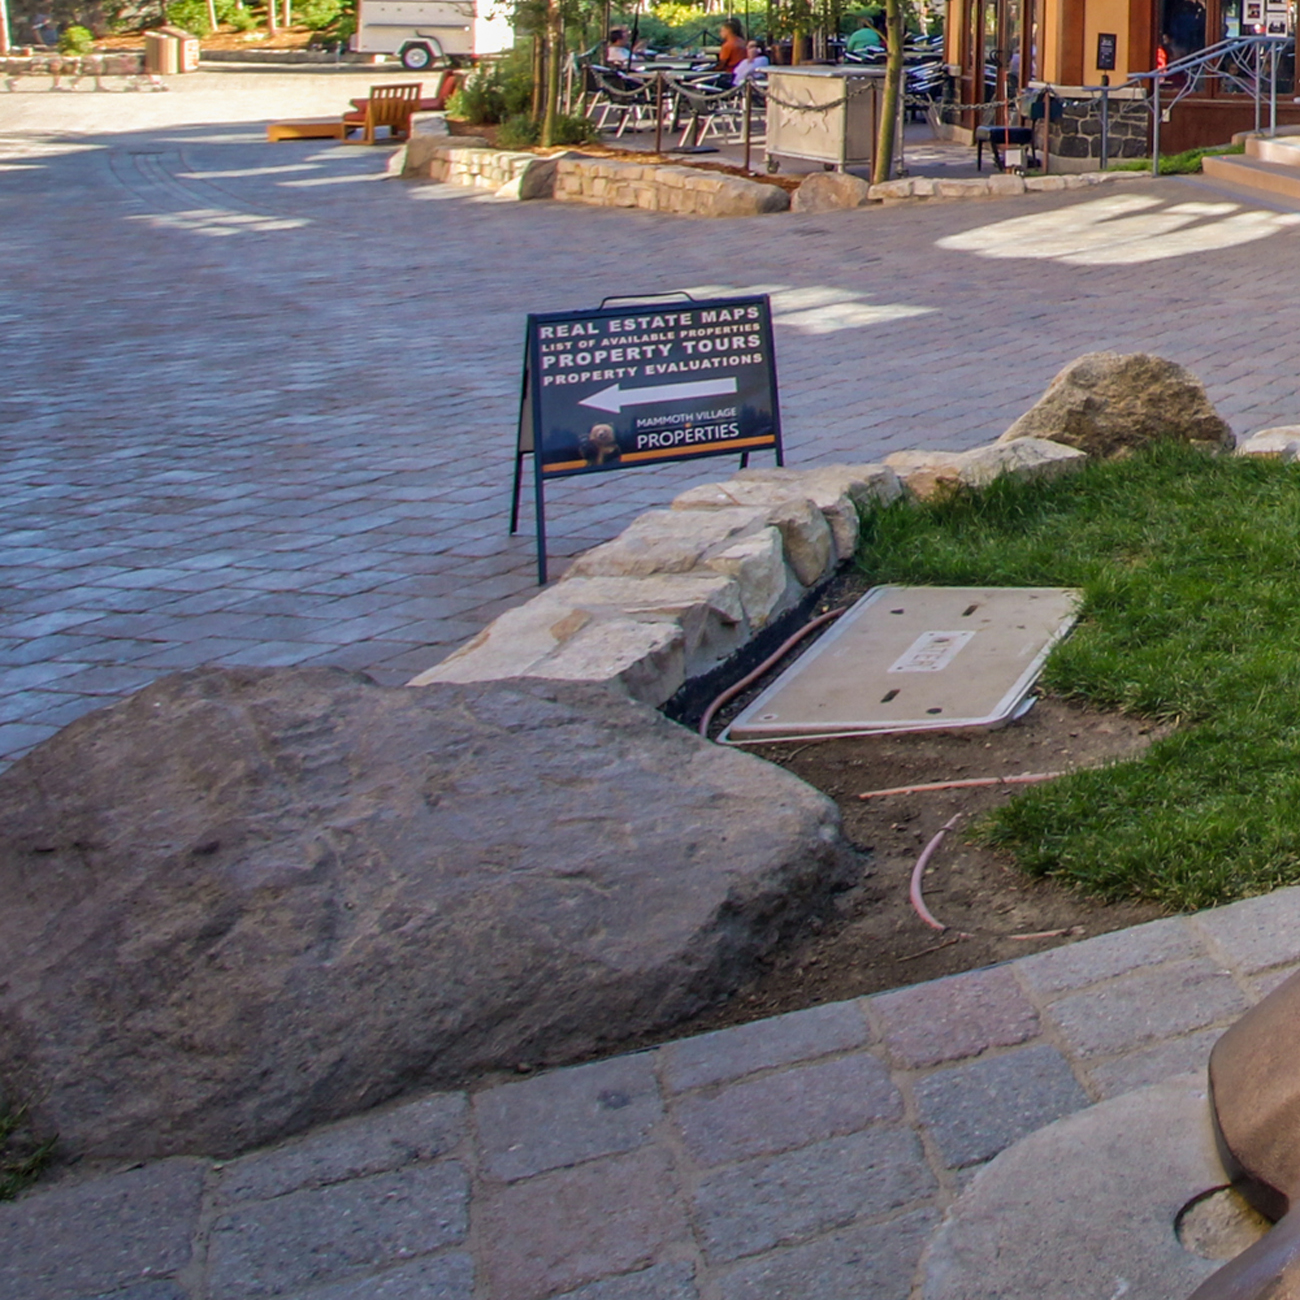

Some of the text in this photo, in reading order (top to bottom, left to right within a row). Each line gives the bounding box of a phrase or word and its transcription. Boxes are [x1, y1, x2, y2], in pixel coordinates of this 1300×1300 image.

[540, 306, 759, 339] REAL ESTATE MAPS
[542, 323, 760, 352] LIST OF AVAILABLE PROPERTIES
[542, 334, 760, 370] PROPERTY TOURS
[543, 353, 762, 386] PROPERTY EVALUATIONS
[636, 407, 737, 428] MAMMOTH VILLAGE
[637, 423, 739, 449] PROPERTIES
